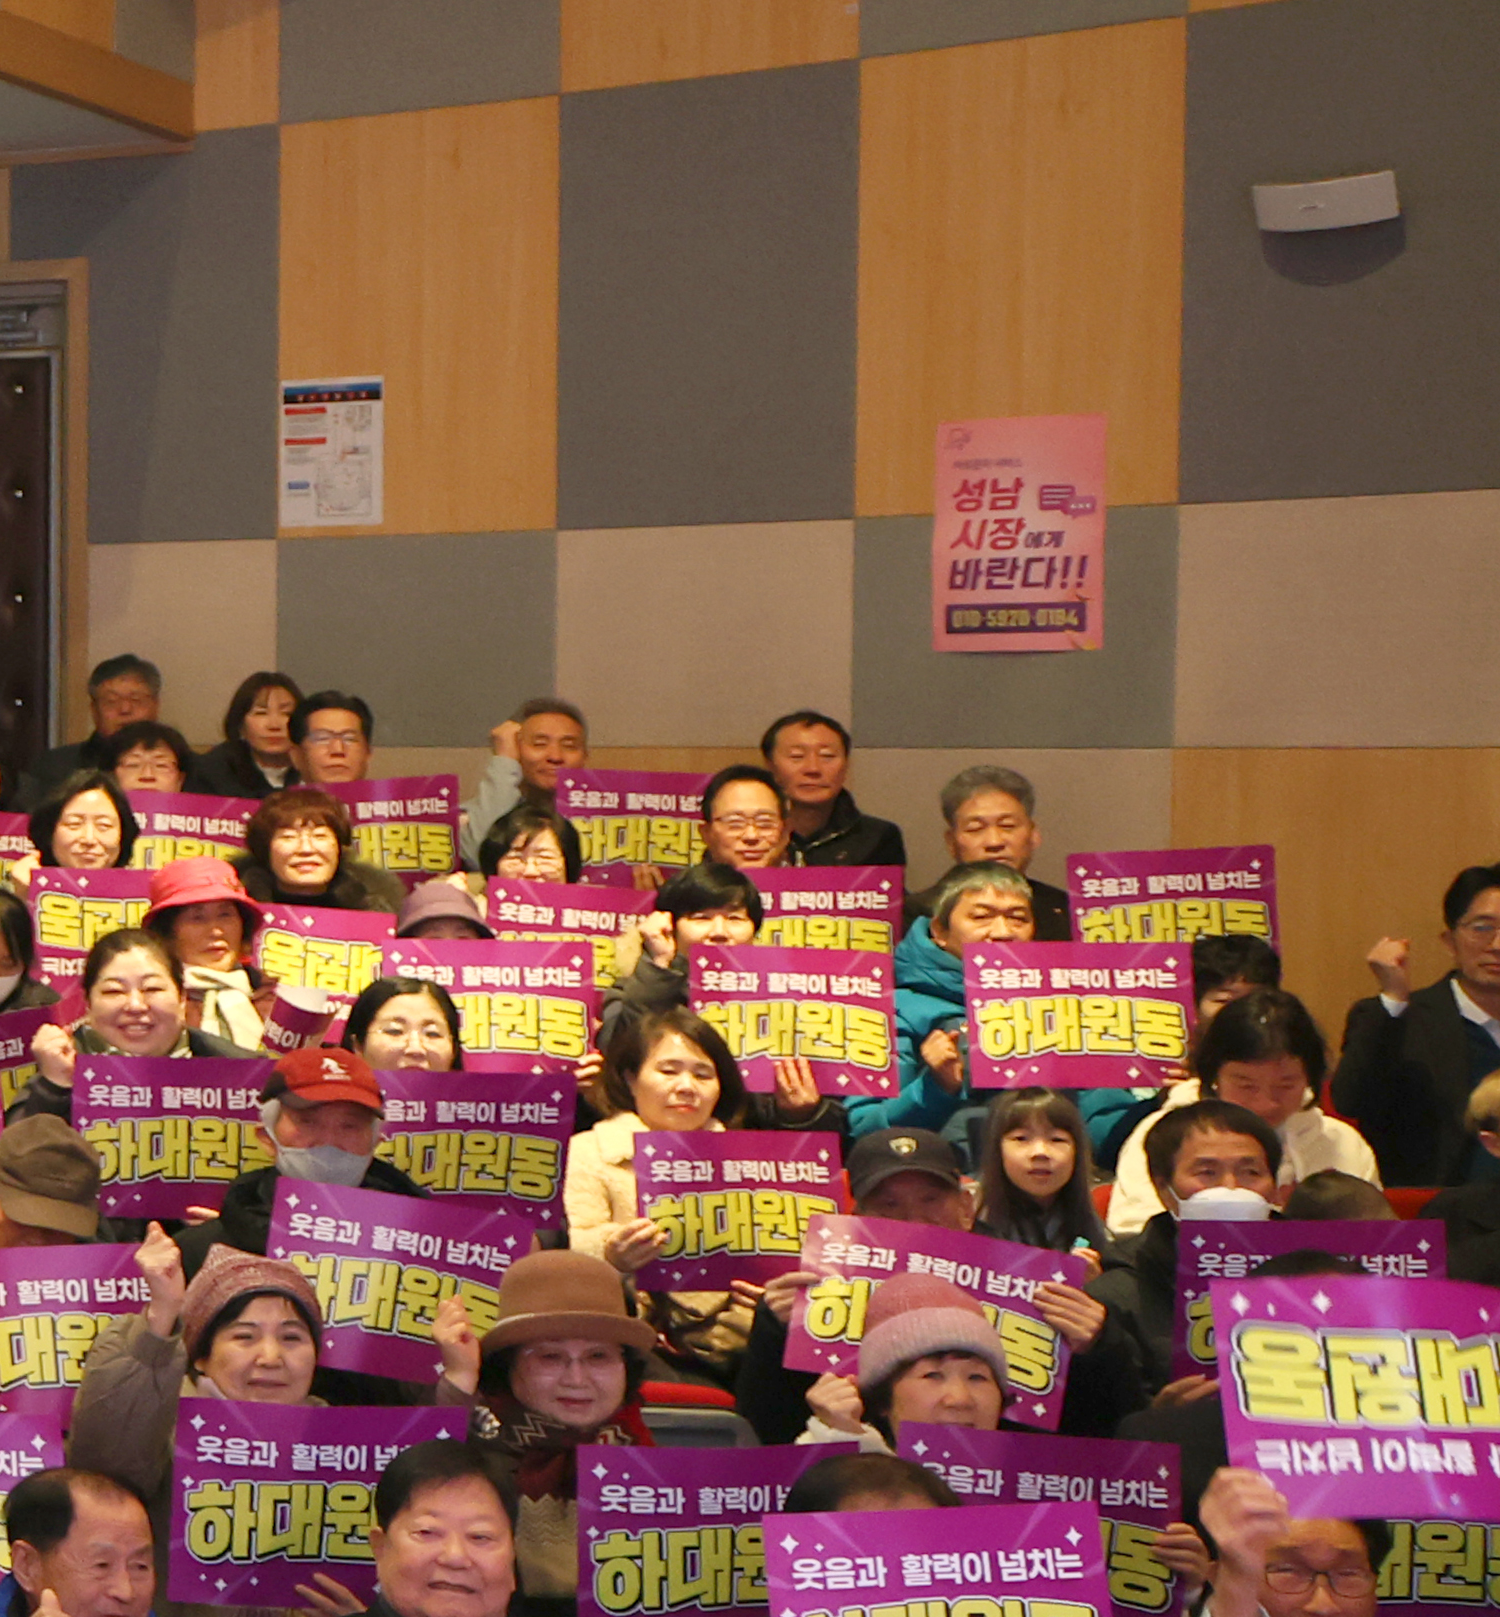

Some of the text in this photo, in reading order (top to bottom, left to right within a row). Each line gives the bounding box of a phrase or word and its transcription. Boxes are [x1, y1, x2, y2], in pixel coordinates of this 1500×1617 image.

[953, 477, 1024, 512] 성남
[949, 555, 1089, 590] 바란다!!
[1081, 871, 1262, 897] 웃음과 활력이 넘치는
[978, 966, 1178, 990] 웃음과 활력이 넘치는
[973, 993, 1189, 1060] 하대원동
[650, 1158, 829, 1184] 웃음과 활력이 넘치는
[792, 1548, 1084, 1592] 웃음과 활력이 넘치는
